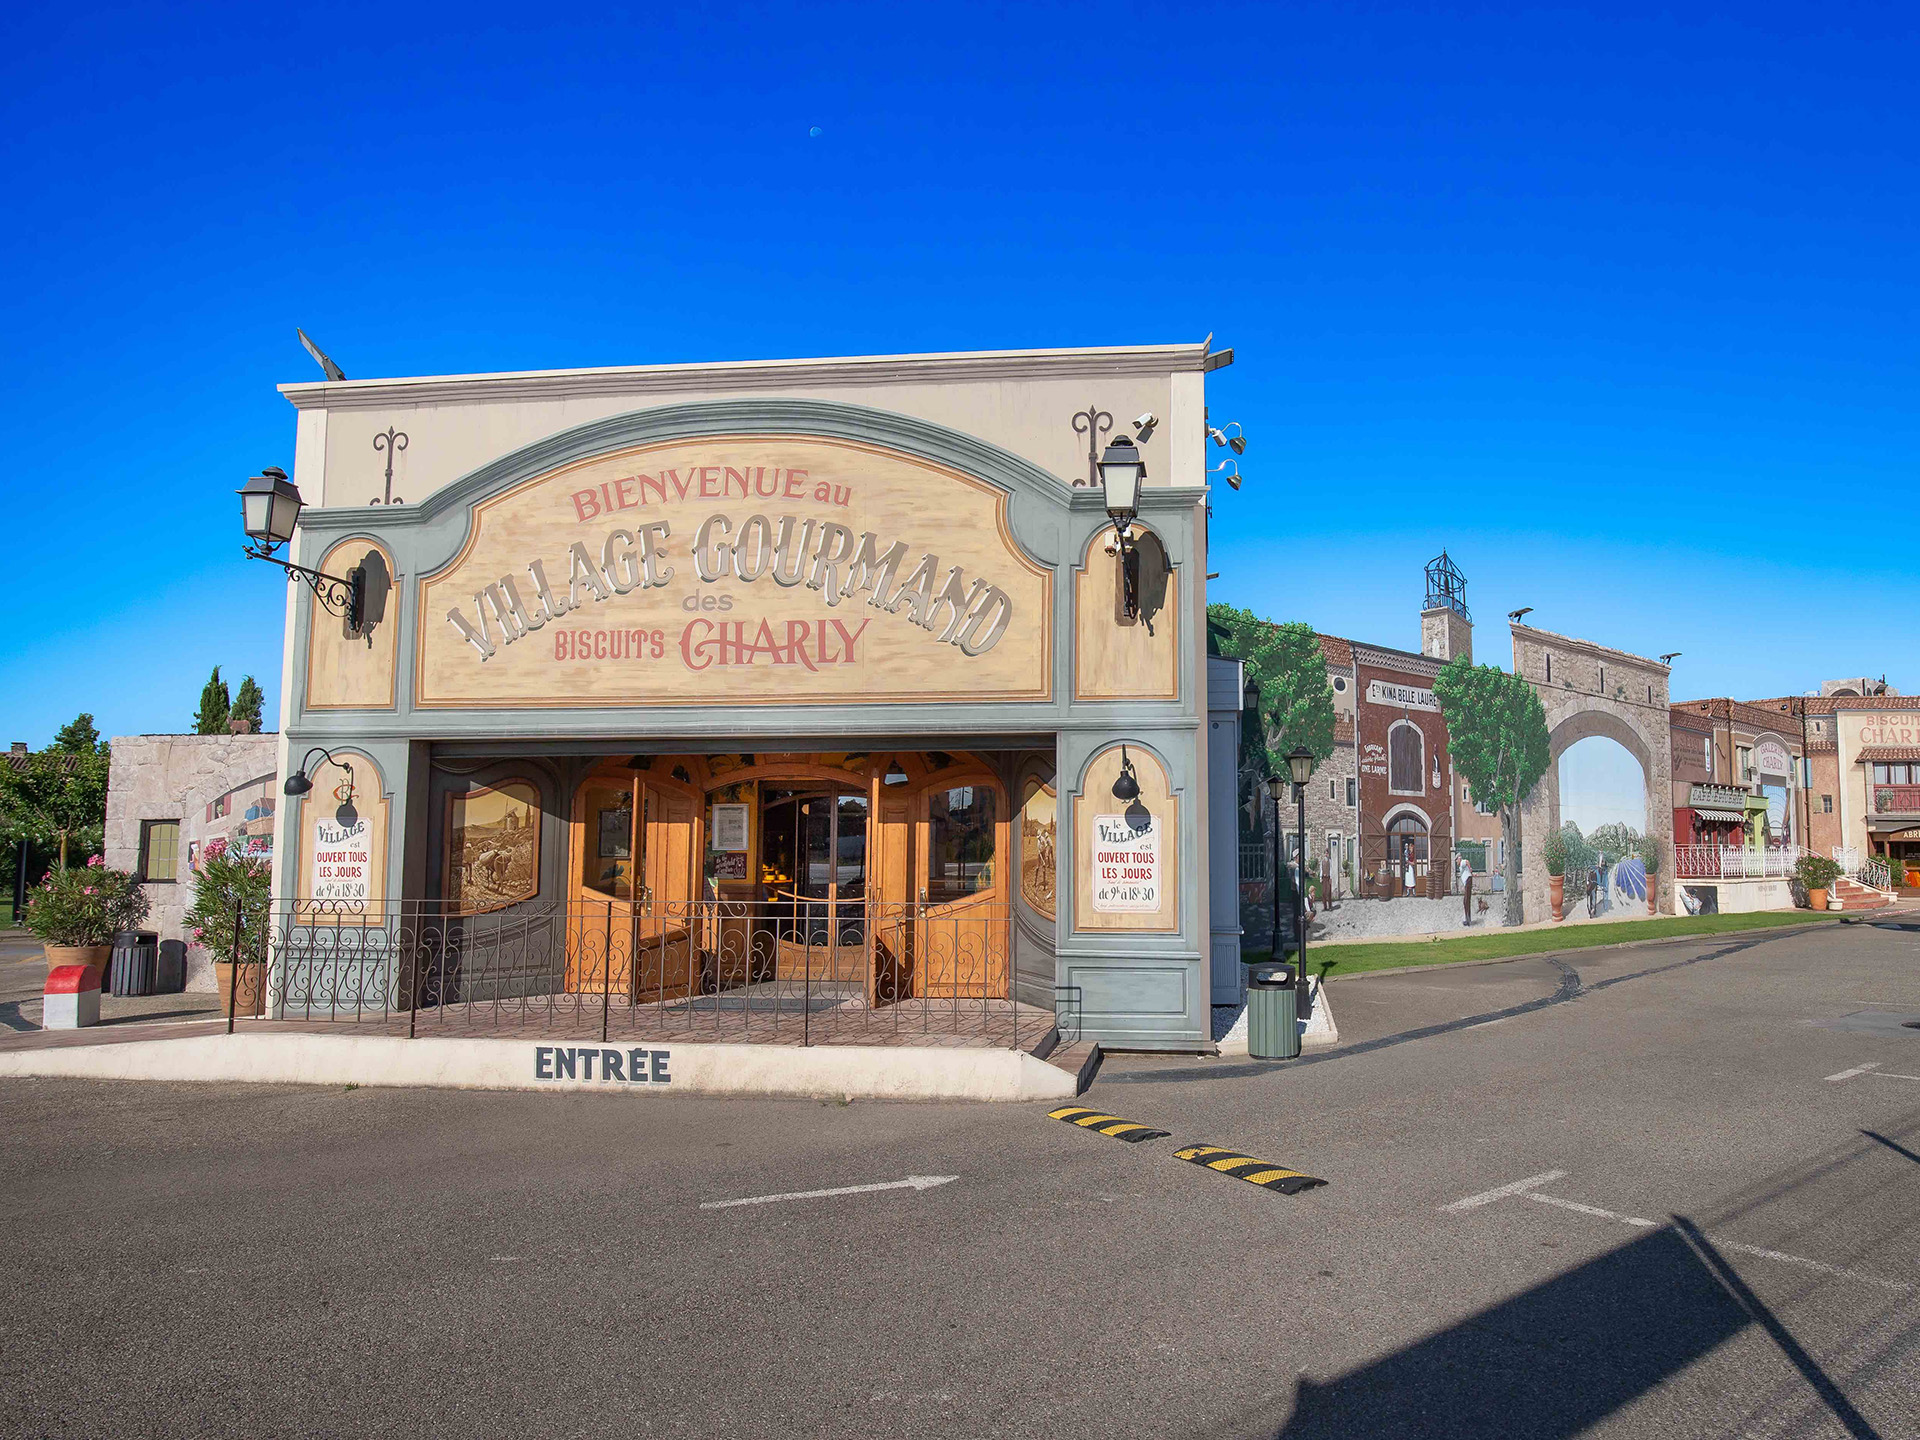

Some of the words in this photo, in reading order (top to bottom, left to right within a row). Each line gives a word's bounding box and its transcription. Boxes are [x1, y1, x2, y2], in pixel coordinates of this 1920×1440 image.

[570, 467, 808, 523] BIENVENUE
[814, 481, 852, 507] au
[446, 519, 675, 662] VILLAGE
[692, 514, 1012, 657] GOURMAND
[682, 588, 734, 612] des
[554, 629, 665, 661] BISCUITS
[678, 617, 873, 672] CHARLY
[1382, 686, 1397, 701] KINA
[1398, 689, 1415, 704] BELLE
[318, 821, 365, 844] VILLAGE
[1099, 821, 1153, 843] VILLAGE
[1113, 819, 1121, 830] le
[316, 851, 347, 863] OUVERT
[348, 852, 368, 863] TOUS
[1097, 851, 1130, 864] OUVERT
[1132, 852, 1155, 864] TOUS
[319, 866, 332, 878] LES
[334, 866, 362, 879] JOURS
[1102, 867, 1117, 879] LES
[1121, 867, 1152, 880] JOURS
[1098, 887, 1109, 900] de
[535, 1046, 672, 1084] ENTRÉE
